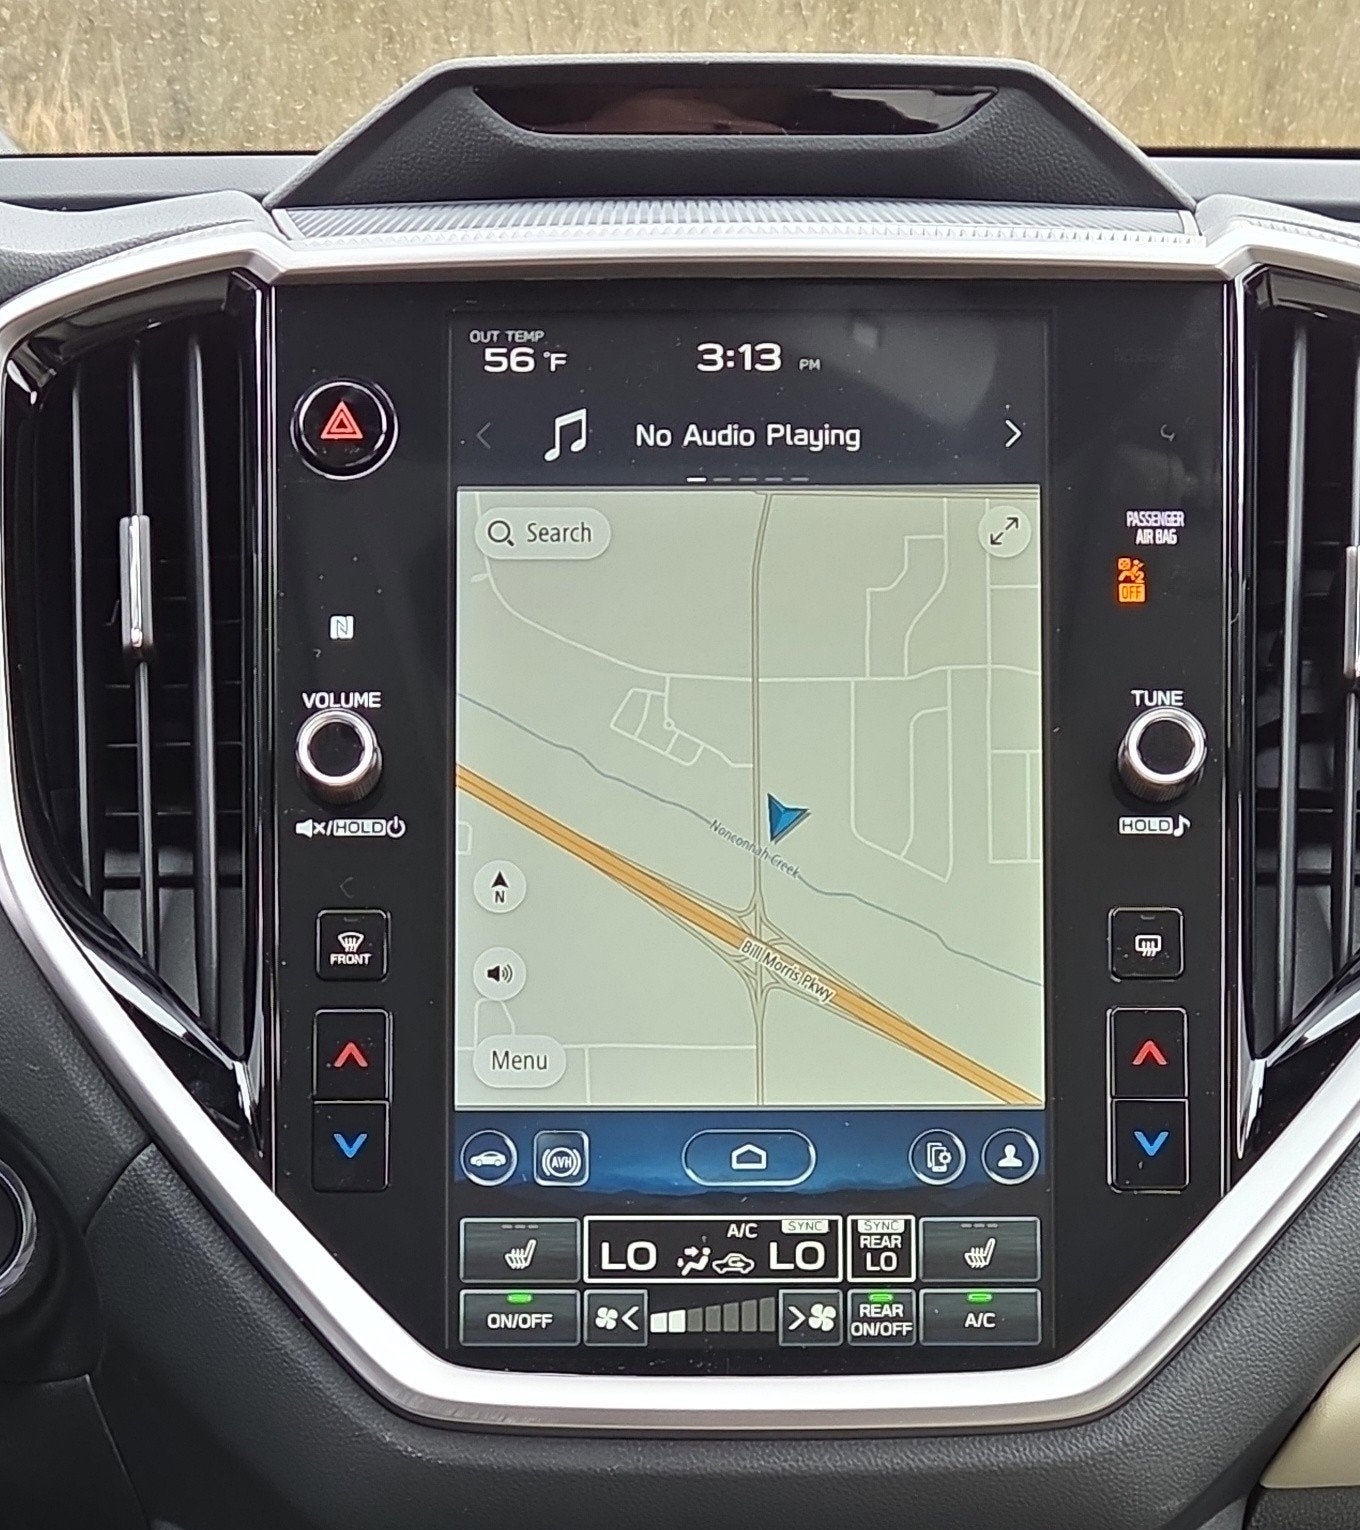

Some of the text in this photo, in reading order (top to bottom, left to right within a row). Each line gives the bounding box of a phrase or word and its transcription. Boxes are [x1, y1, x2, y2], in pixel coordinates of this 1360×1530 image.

[469, 330, 545, 343] OUT TEMP
[484, 347, 535, 373] 56
[697, 343, 821, 372] 3:13 PM
[635, 423, 861, 452] No Audio Playing
[1126, 511, 1185, 527] PASSENGER
[527, 522, 592, 543] Search
[1135, 529, 1178, 545] AIR BAG
[1120, 586, 1142, 599] OFF
[302, 692, 382, 708] VOLUME
[1131, 690, 1184, 706] TUNE
[1121, 819, 1171, 832] HOLD
[710, 819, 802, 878] Nonconnah Creek
[495, 891, 505, 902] N
[330, 953, 372, 965] FRONT
[741, 941, 834, 1001] Bill Morris Pkwy
[491, 1050, 548, 1070] Menu
[551, 1157, 572, 1168] AVH
[727, 1223, 758, 1239] A/C
[788, 1220, 824, 1232] SYNC
[864, 1220, 899, 1232] SYNC
[860, 1235, 902, 1249] REAR
[601, 1241, 657, 1271] LO
[769, 1241, 826, 1271] LO
[866, 1251, 897, 1272] LO
[859, 1303, 904, 1318] REAR
[486, 1313, 553, 1330] ON/OFF
[850, 1321, 913, 1337] ON/OFF
[964, 1313, 996, 1329] A/C
